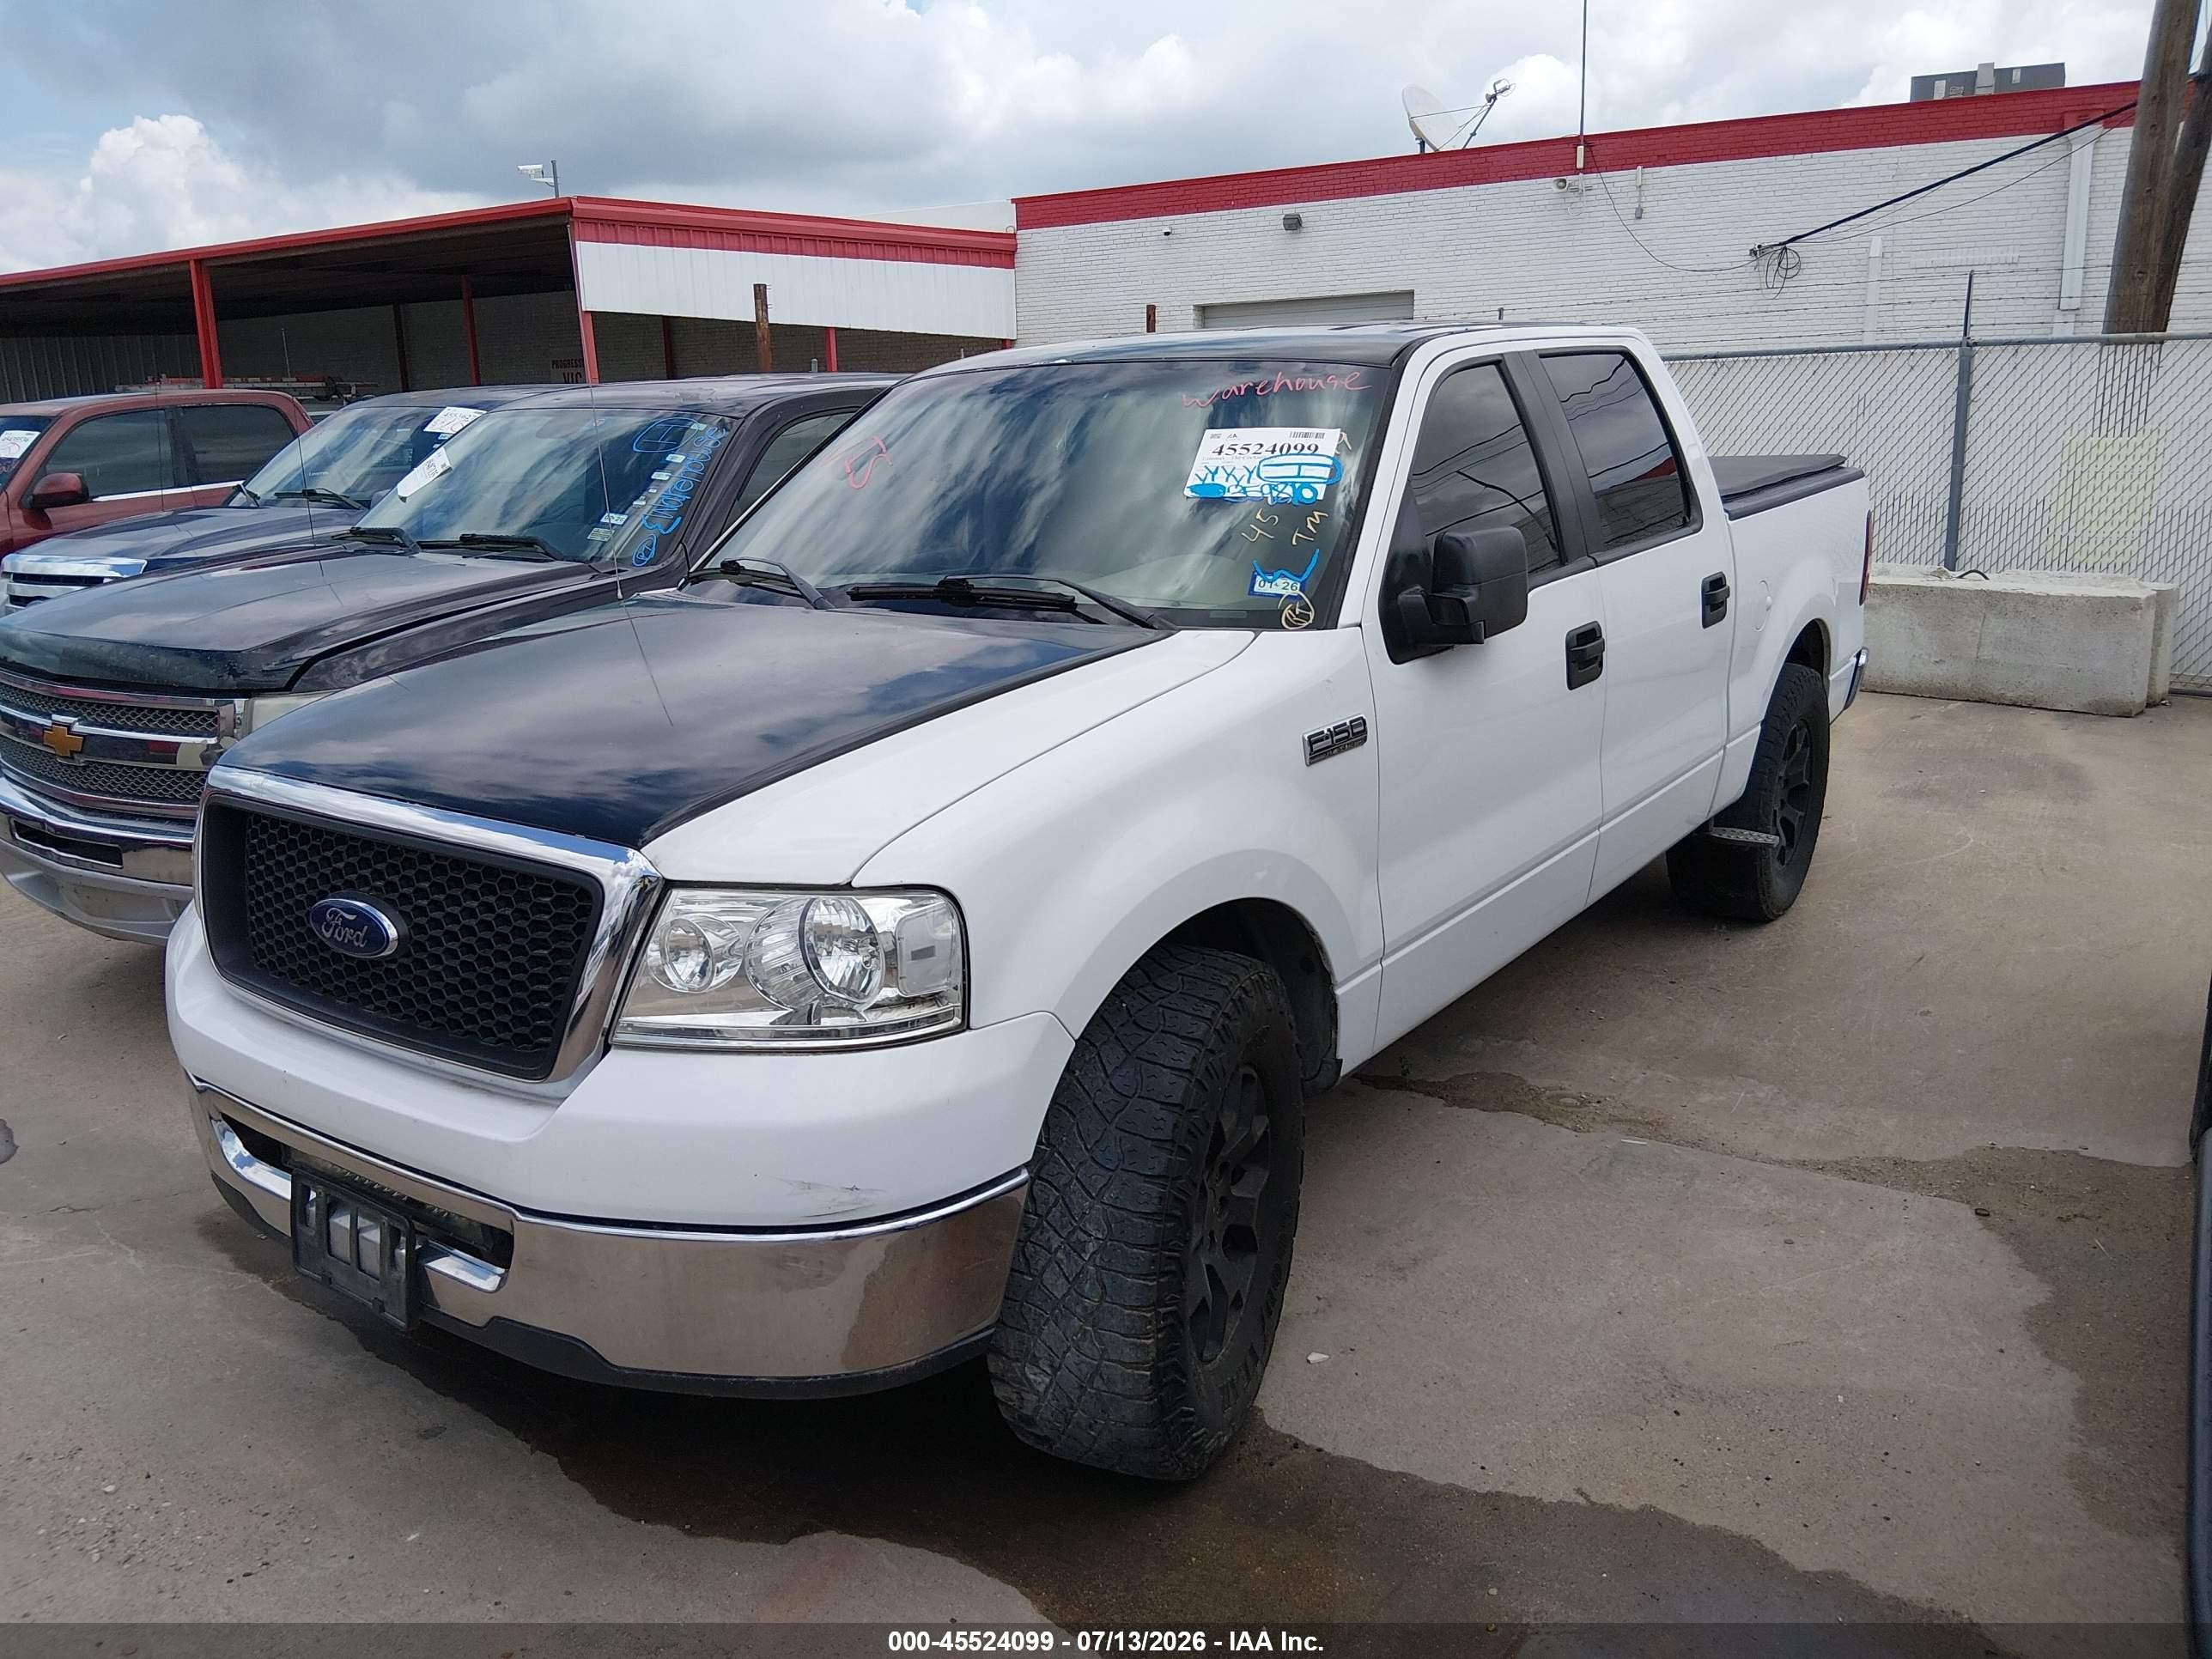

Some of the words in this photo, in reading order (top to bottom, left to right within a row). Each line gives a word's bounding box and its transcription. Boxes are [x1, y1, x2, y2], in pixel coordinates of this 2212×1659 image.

[1182, 372, 1372, 407] warehouse
[1212, 443, 1320, 456] 45524099
[321, 907, 371, 948] Ford
